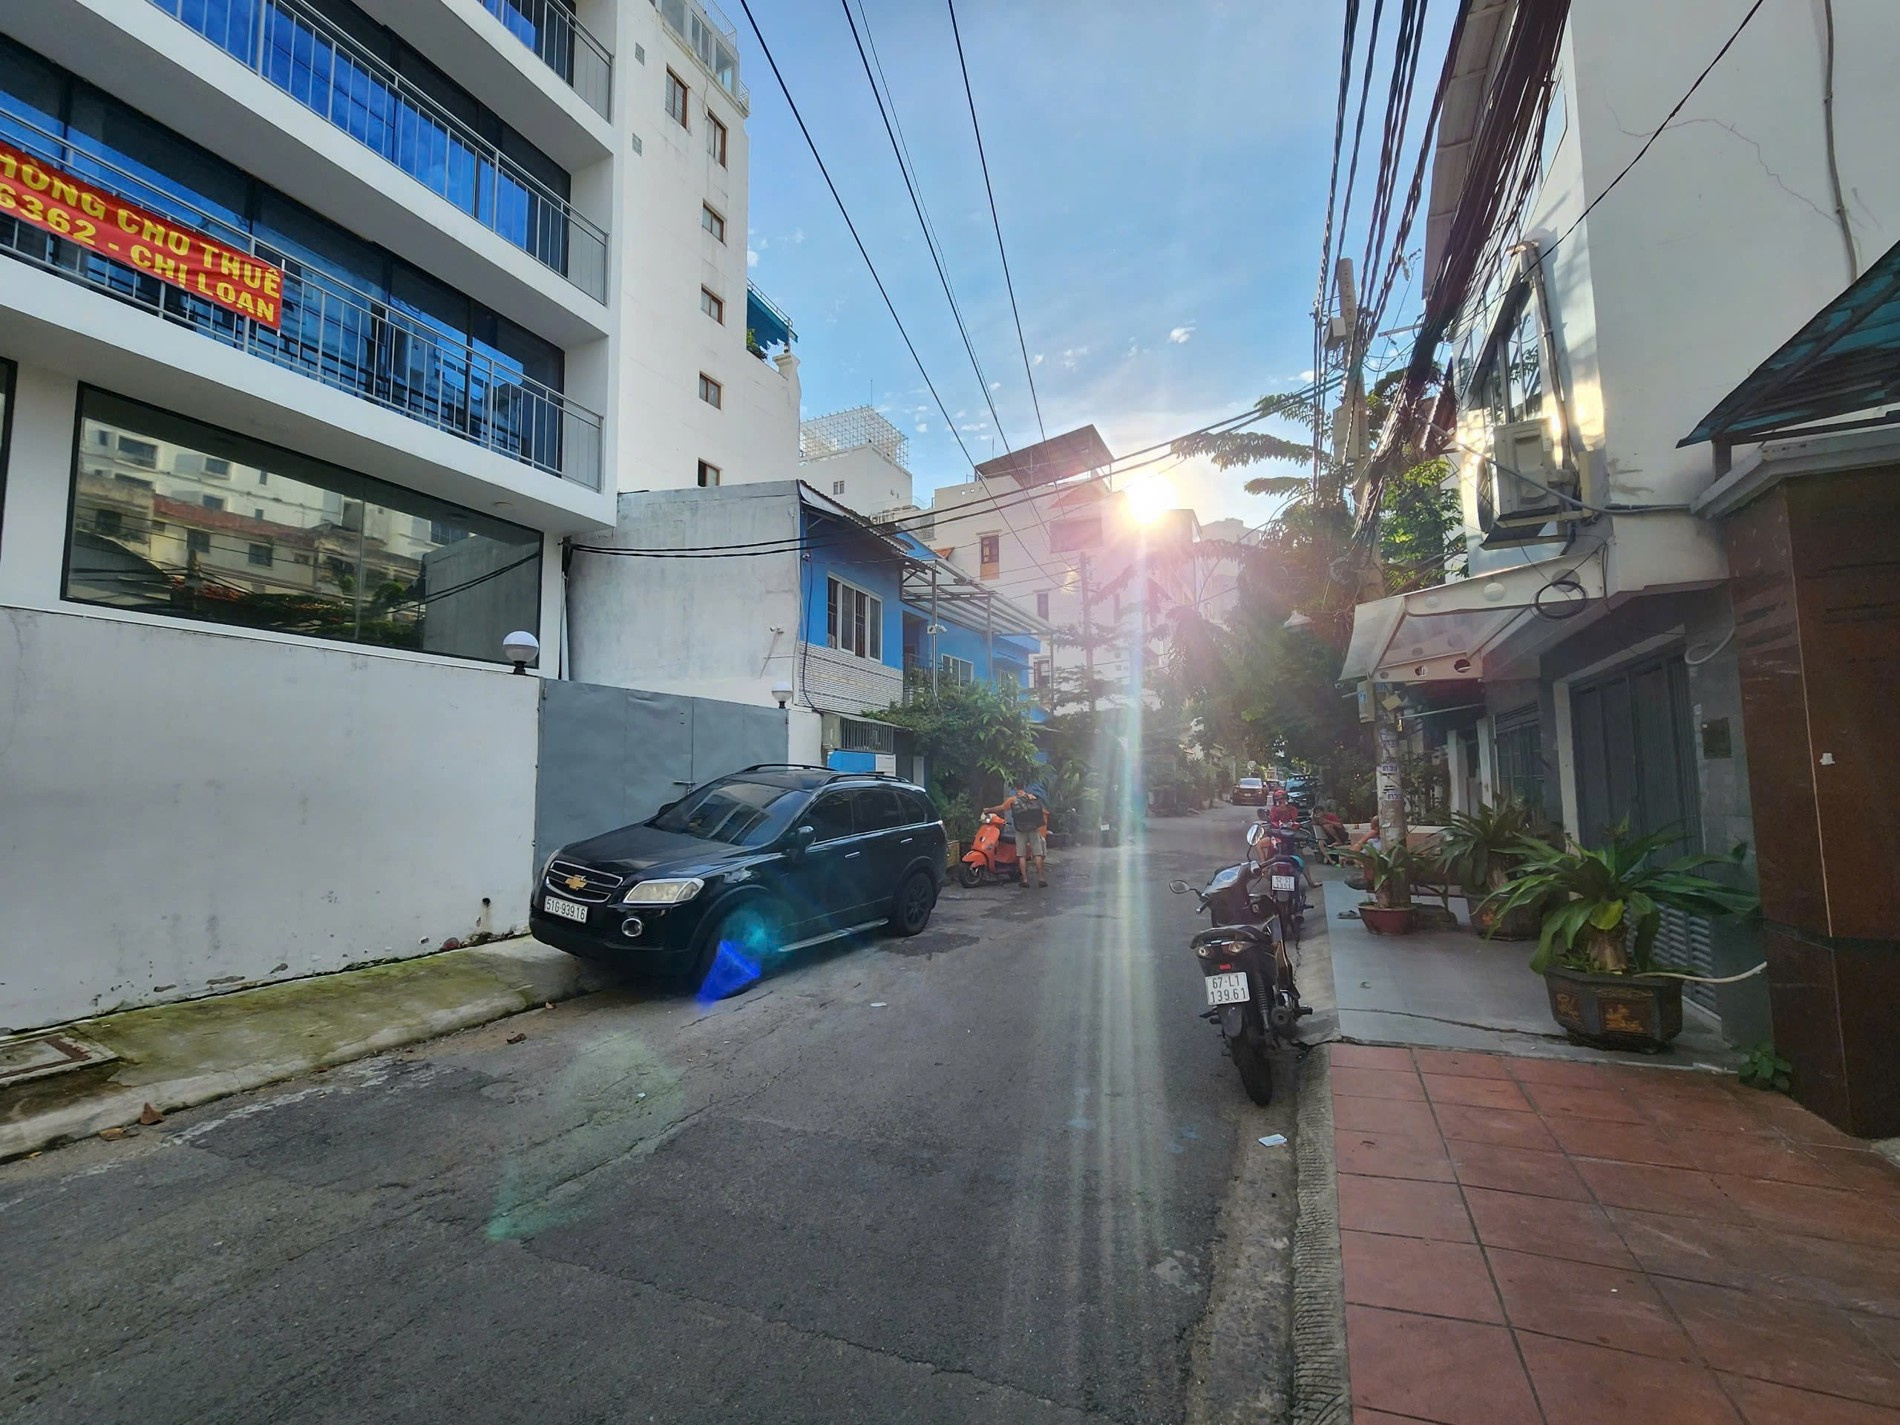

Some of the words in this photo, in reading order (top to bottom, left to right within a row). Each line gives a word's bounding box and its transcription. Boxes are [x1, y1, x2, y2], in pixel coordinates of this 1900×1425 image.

[0, 183, 97, 246] 6362
[130, 244, 187, 289] CHỊ
[197, 272, 274, 323] LOAN
[117, 208, 190, 256] CHO
[200, 242, 281, 298] THUÊ
[1210, 987, 1246, 1003] 139.61
